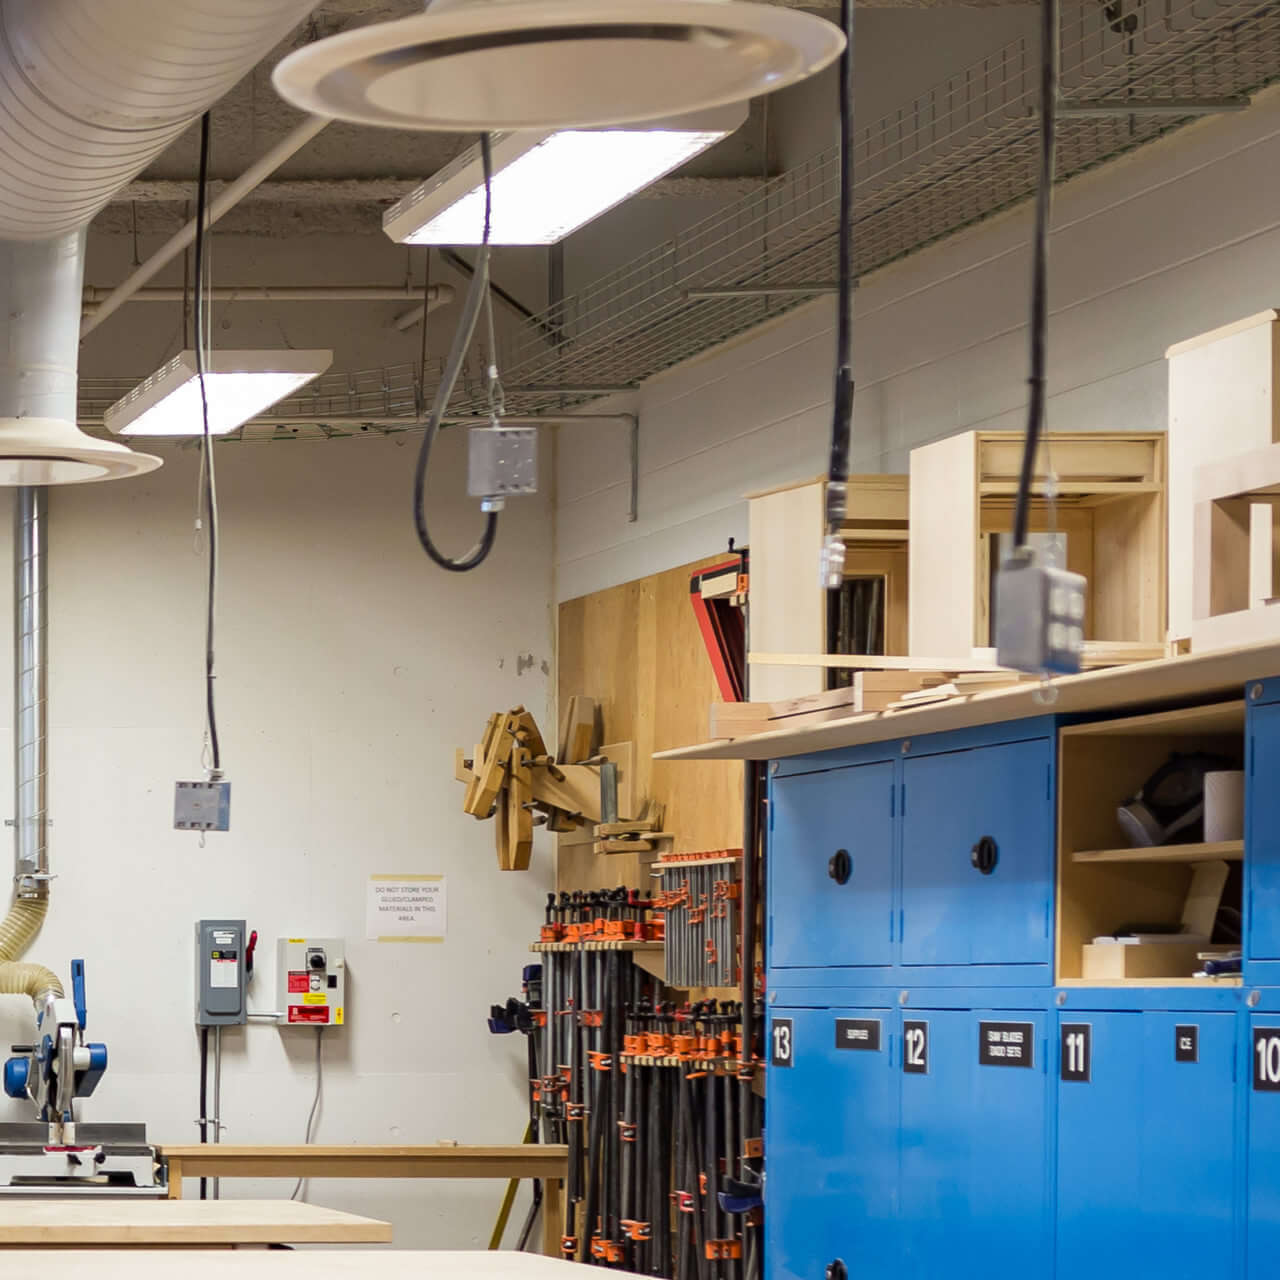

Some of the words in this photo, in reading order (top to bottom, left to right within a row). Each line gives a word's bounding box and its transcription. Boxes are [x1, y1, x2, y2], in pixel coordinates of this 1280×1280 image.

[773, 1026, 791, 1060] 13
[905, 1028, 926, 1066] 12
[1065, 1032, 1085, 1073] 11
[1255, 1036, 1280, 1083] 10
